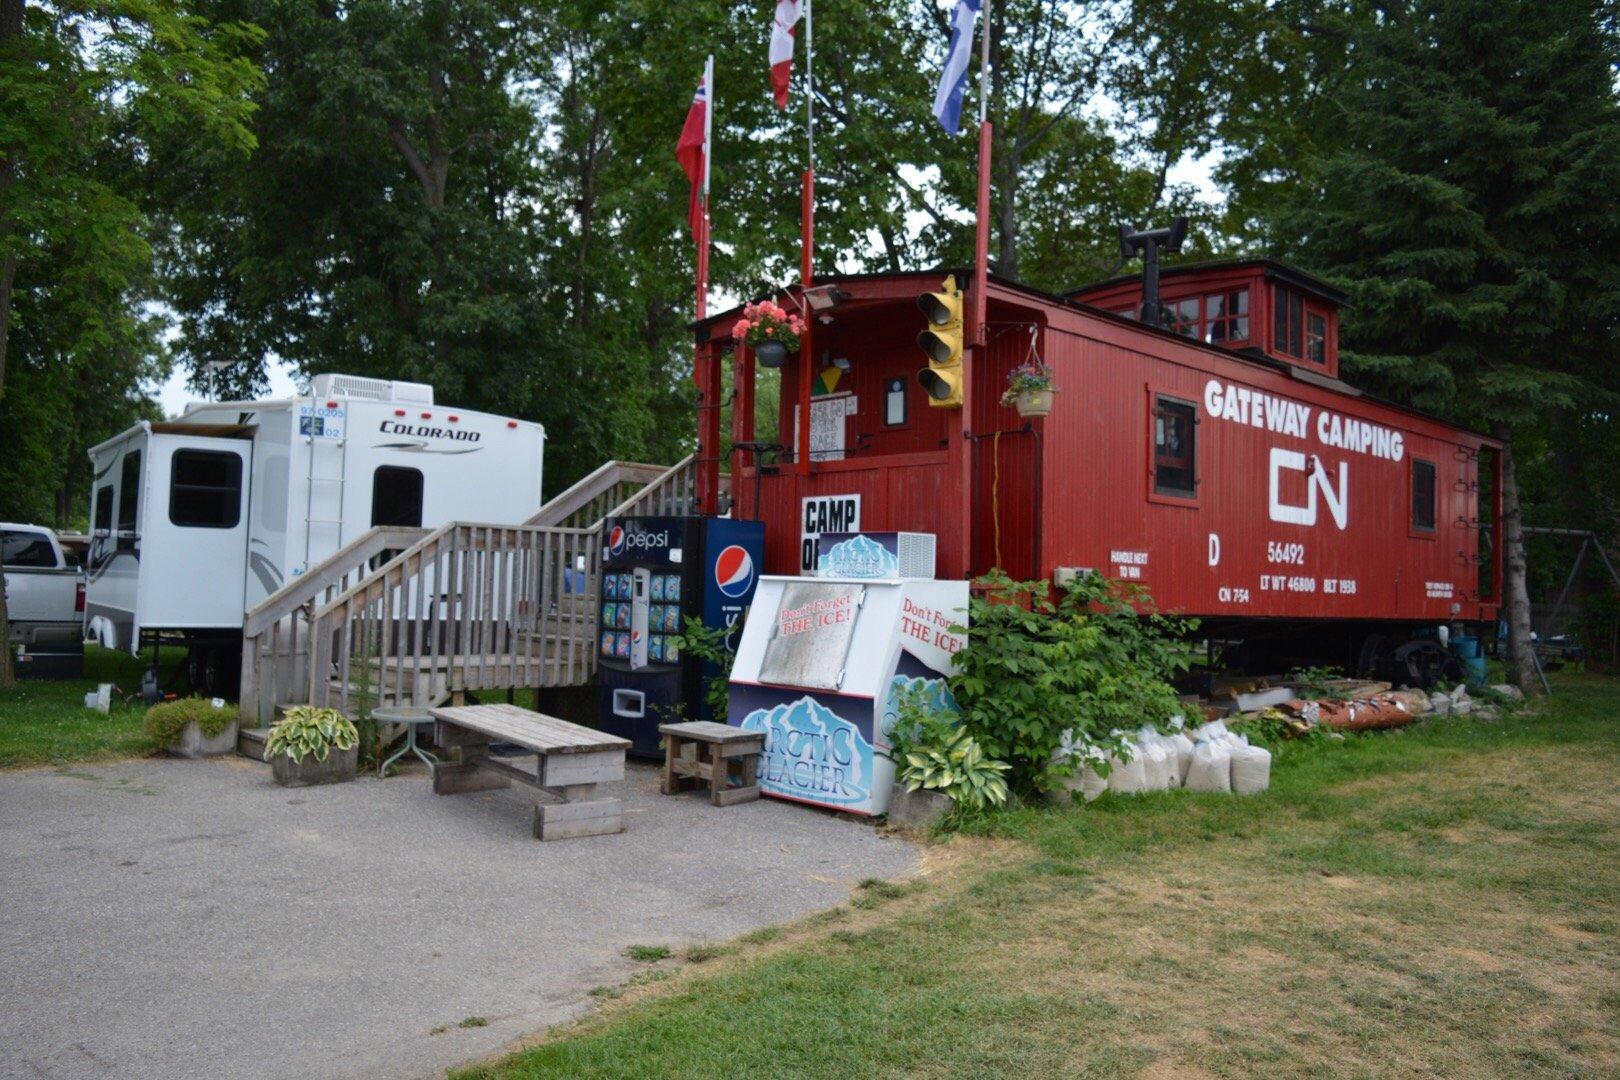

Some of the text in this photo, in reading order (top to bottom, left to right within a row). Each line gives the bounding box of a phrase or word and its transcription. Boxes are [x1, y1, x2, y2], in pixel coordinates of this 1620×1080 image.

[379, 420, 482, 442] COLORADO
[1204, 379, 1404, 462] GATEWAY CAMPING
[1268, 447, 1348, 531] CN
[806, 499, 856, 533] CAMP
[626, 530, 669, 550] pepsi
[1208, 533, 1220, 567] D
[1267, 541, 1305, 565] 56492
[1218, 587, 1231, 603] CN
[1260, 574, 1270, 591] LT
[1271, 575, 1286, 592] WT
[781, 595, 850, 621] Don't Forget
[903, 598, 931, 622] Don't
[782, 608, 850, 635] THE ICE!
[902, 616, 964, 654] THE ICE!
